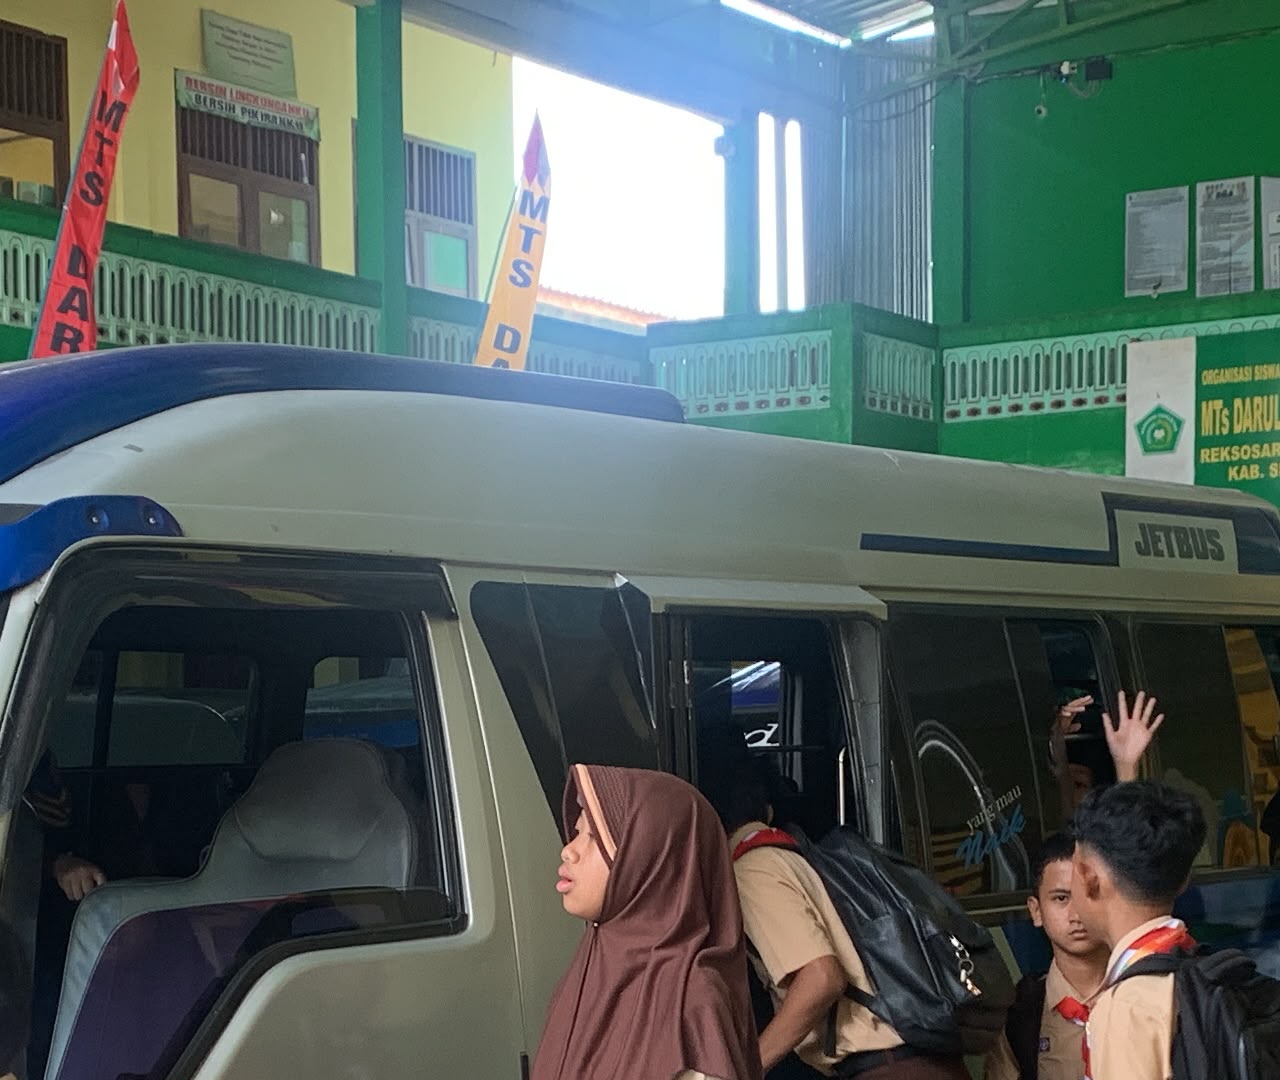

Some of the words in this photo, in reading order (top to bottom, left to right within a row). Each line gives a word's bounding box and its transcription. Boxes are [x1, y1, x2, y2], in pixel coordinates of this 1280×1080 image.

[79, 90, 127, 207] MTS
[509, 189, 550, 288] MTS
[1202, 365, 1253, 385] ORGANISASI
[1201, 399, 1230, 436] MTs
[1228, 464, 1264, 481] KAB.
[1135, 523, 1225, 561] JETBUS
